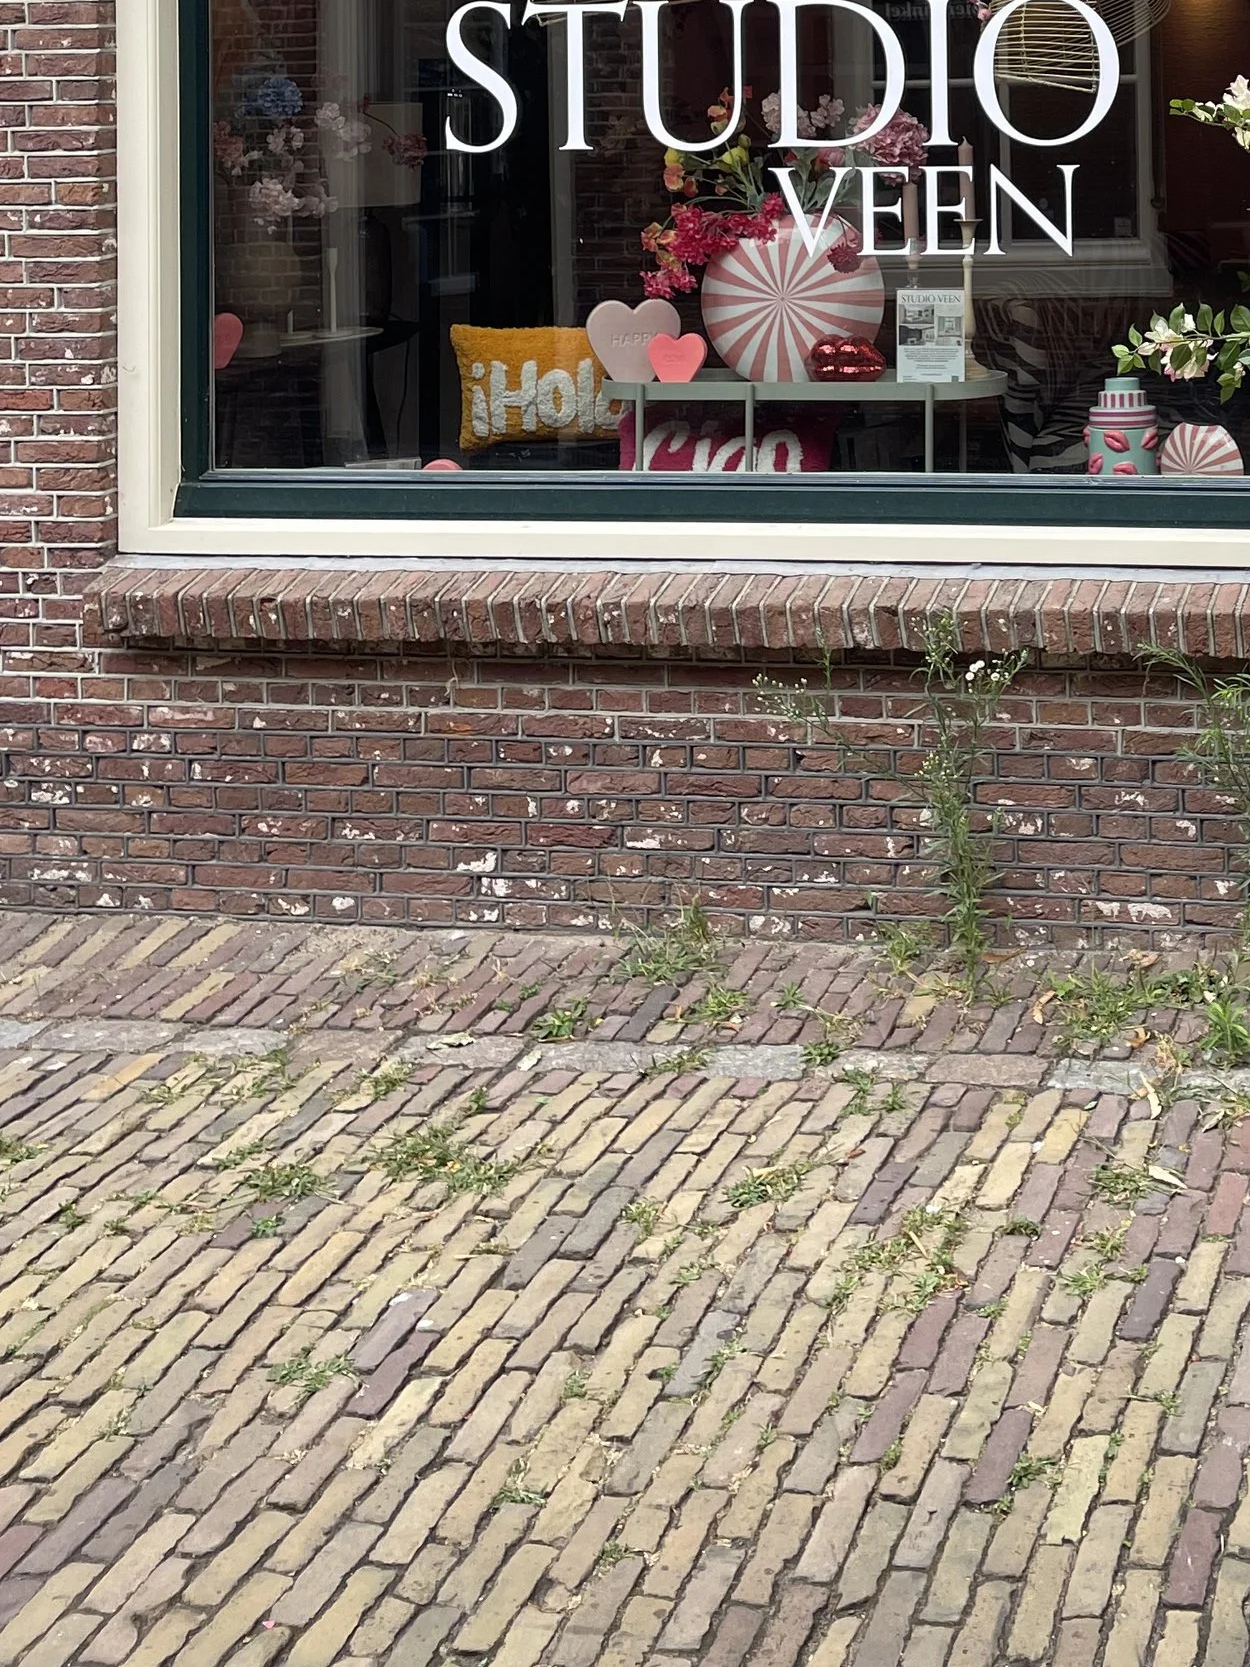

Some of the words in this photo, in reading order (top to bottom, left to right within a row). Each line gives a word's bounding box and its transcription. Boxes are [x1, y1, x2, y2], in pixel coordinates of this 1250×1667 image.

[768, 163, 1080, 258] VEEN
[902, 294, 936, 304] STUDIO
[937, 294, 961, 303] VEEN
